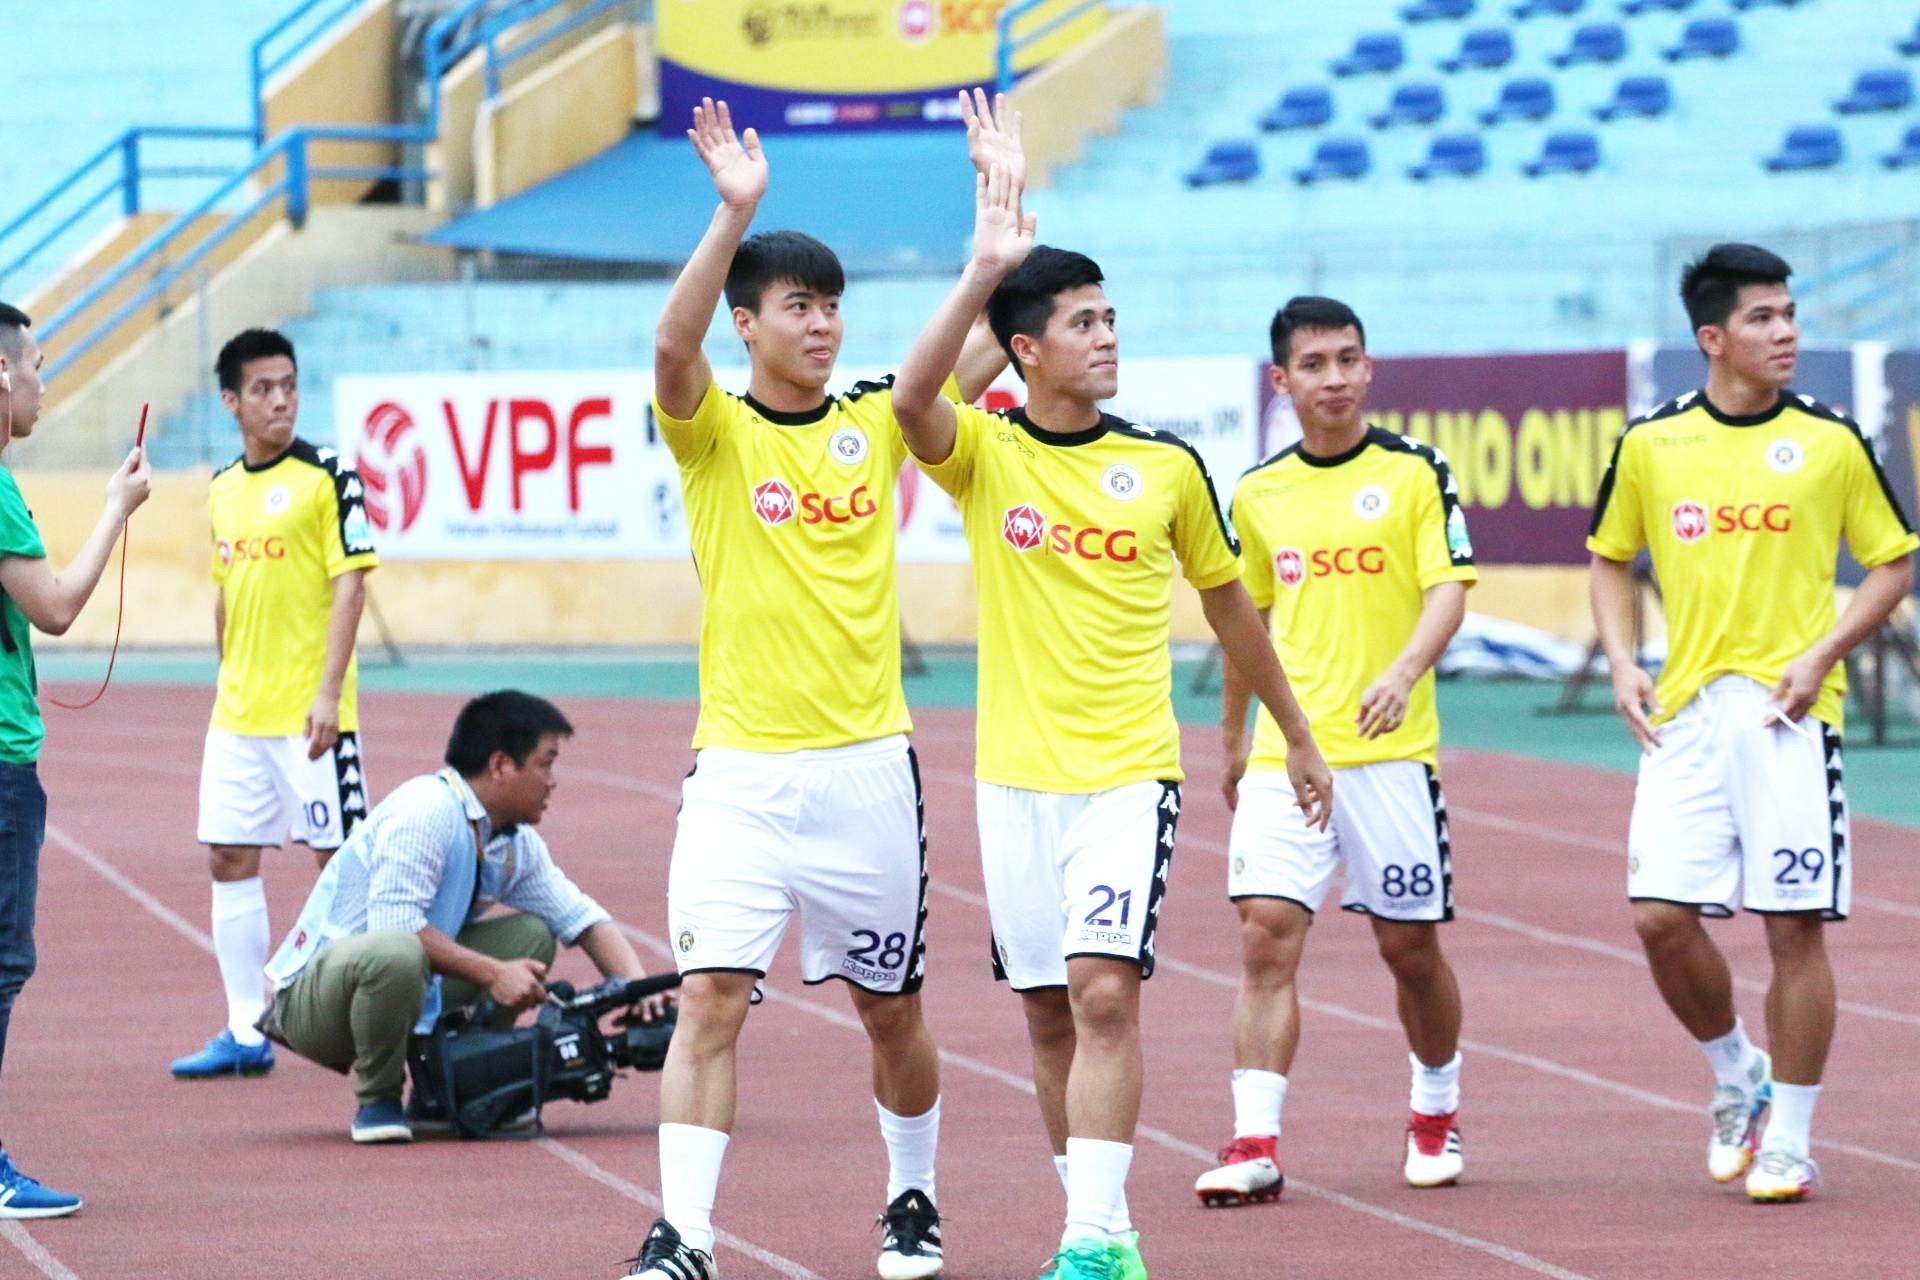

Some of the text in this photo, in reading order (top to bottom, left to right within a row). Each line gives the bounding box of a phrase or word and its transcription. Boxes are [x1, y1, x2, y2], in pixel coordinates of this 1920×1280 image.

[442, 397, 613, 513] VPF
[801, 485, 877, 525] SCG
[1715, 503, 1792, 533] SCG
[235, 536, 286, 560] SCG
[1051, 524, 1138, 562] SCG
[1311, 546, 1385, 576] SCG
[303, 800, 329, 829] 10
[1383, 863, 1434, 897] 88
[1773, 848, 1824, 884] 29
[1084, 884, 1132, 929] 21
[846, 929, 906, 970] 28
[842, 959, 897, 982] Kappa
